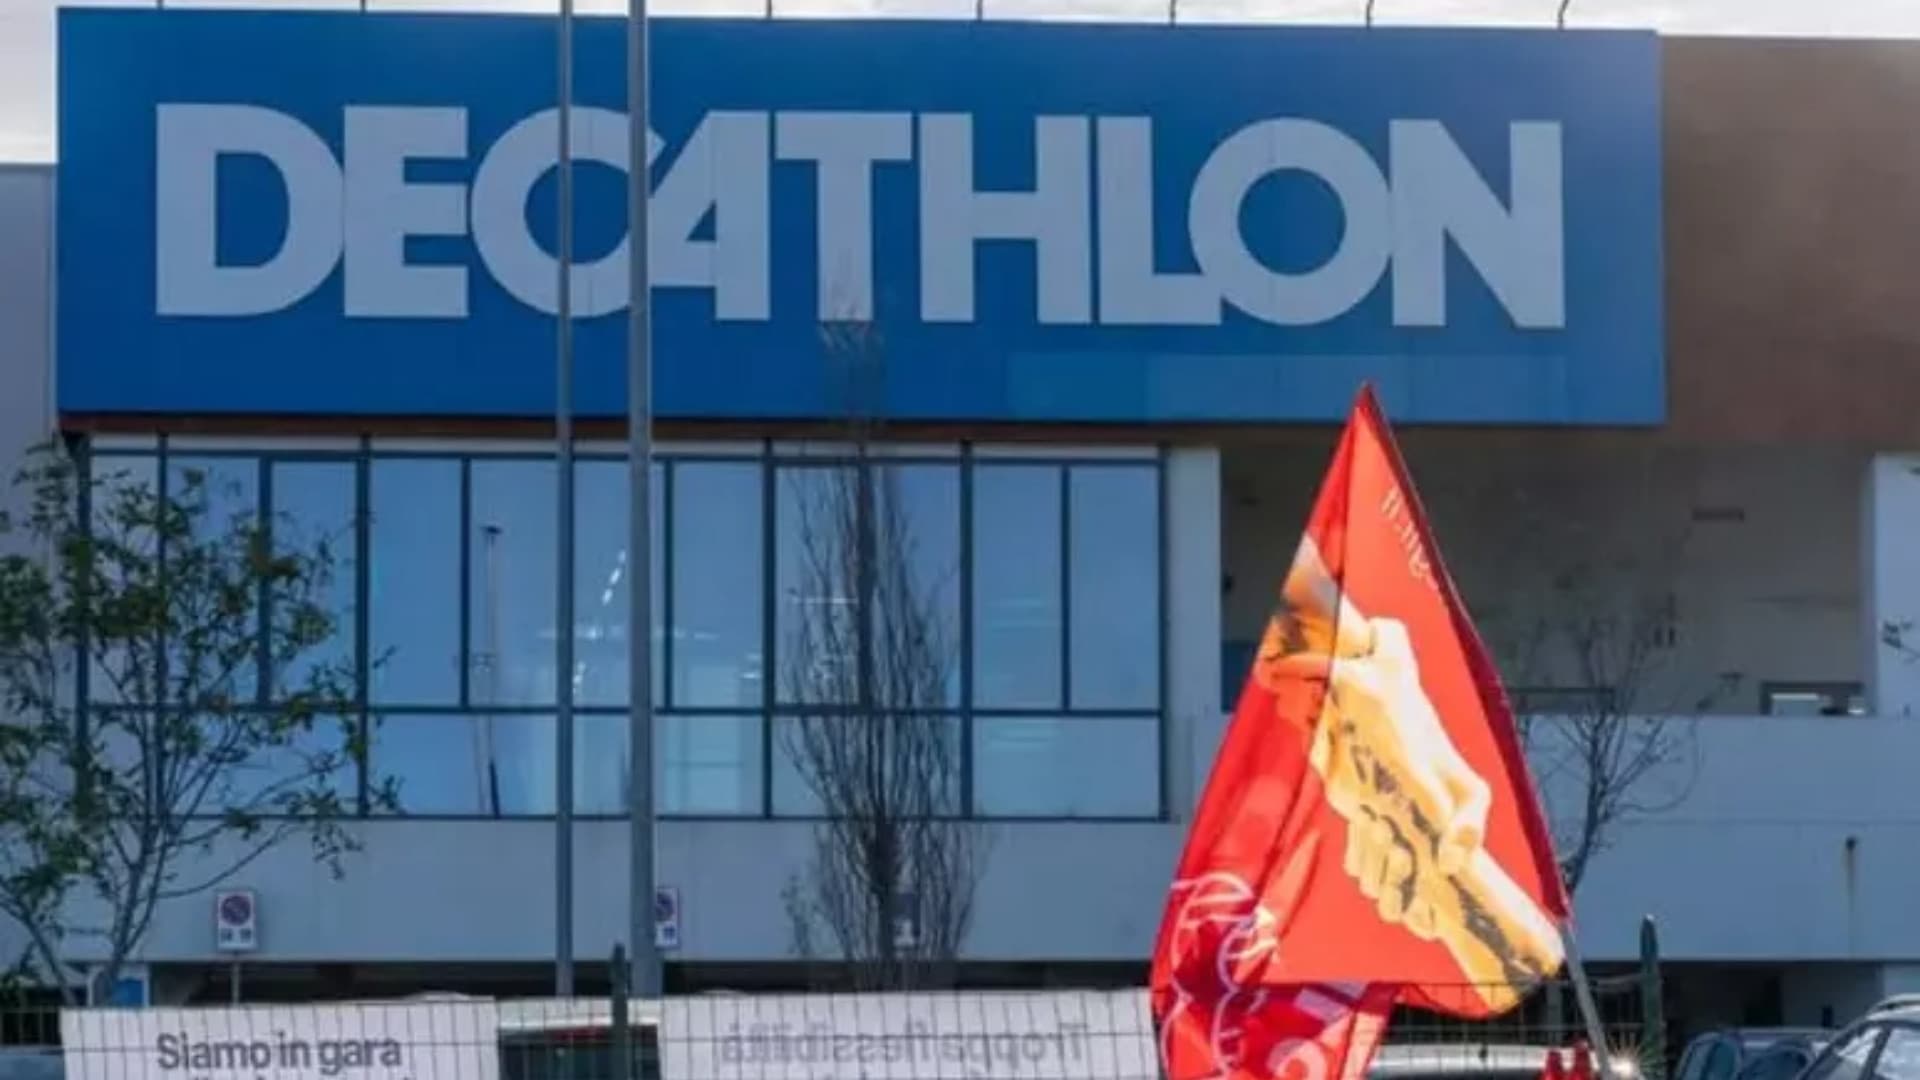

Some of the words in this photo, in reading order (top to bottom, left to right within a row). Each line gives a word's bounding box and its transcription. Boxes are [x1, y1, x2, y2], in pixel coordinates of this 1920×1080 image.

[155, 103, 1566, 329] DECATHLON
[156, 1031, 271, 1070] Siamo
[277, 1030, 311, 1068] in
[318, 1038, 403, 1076] gara
